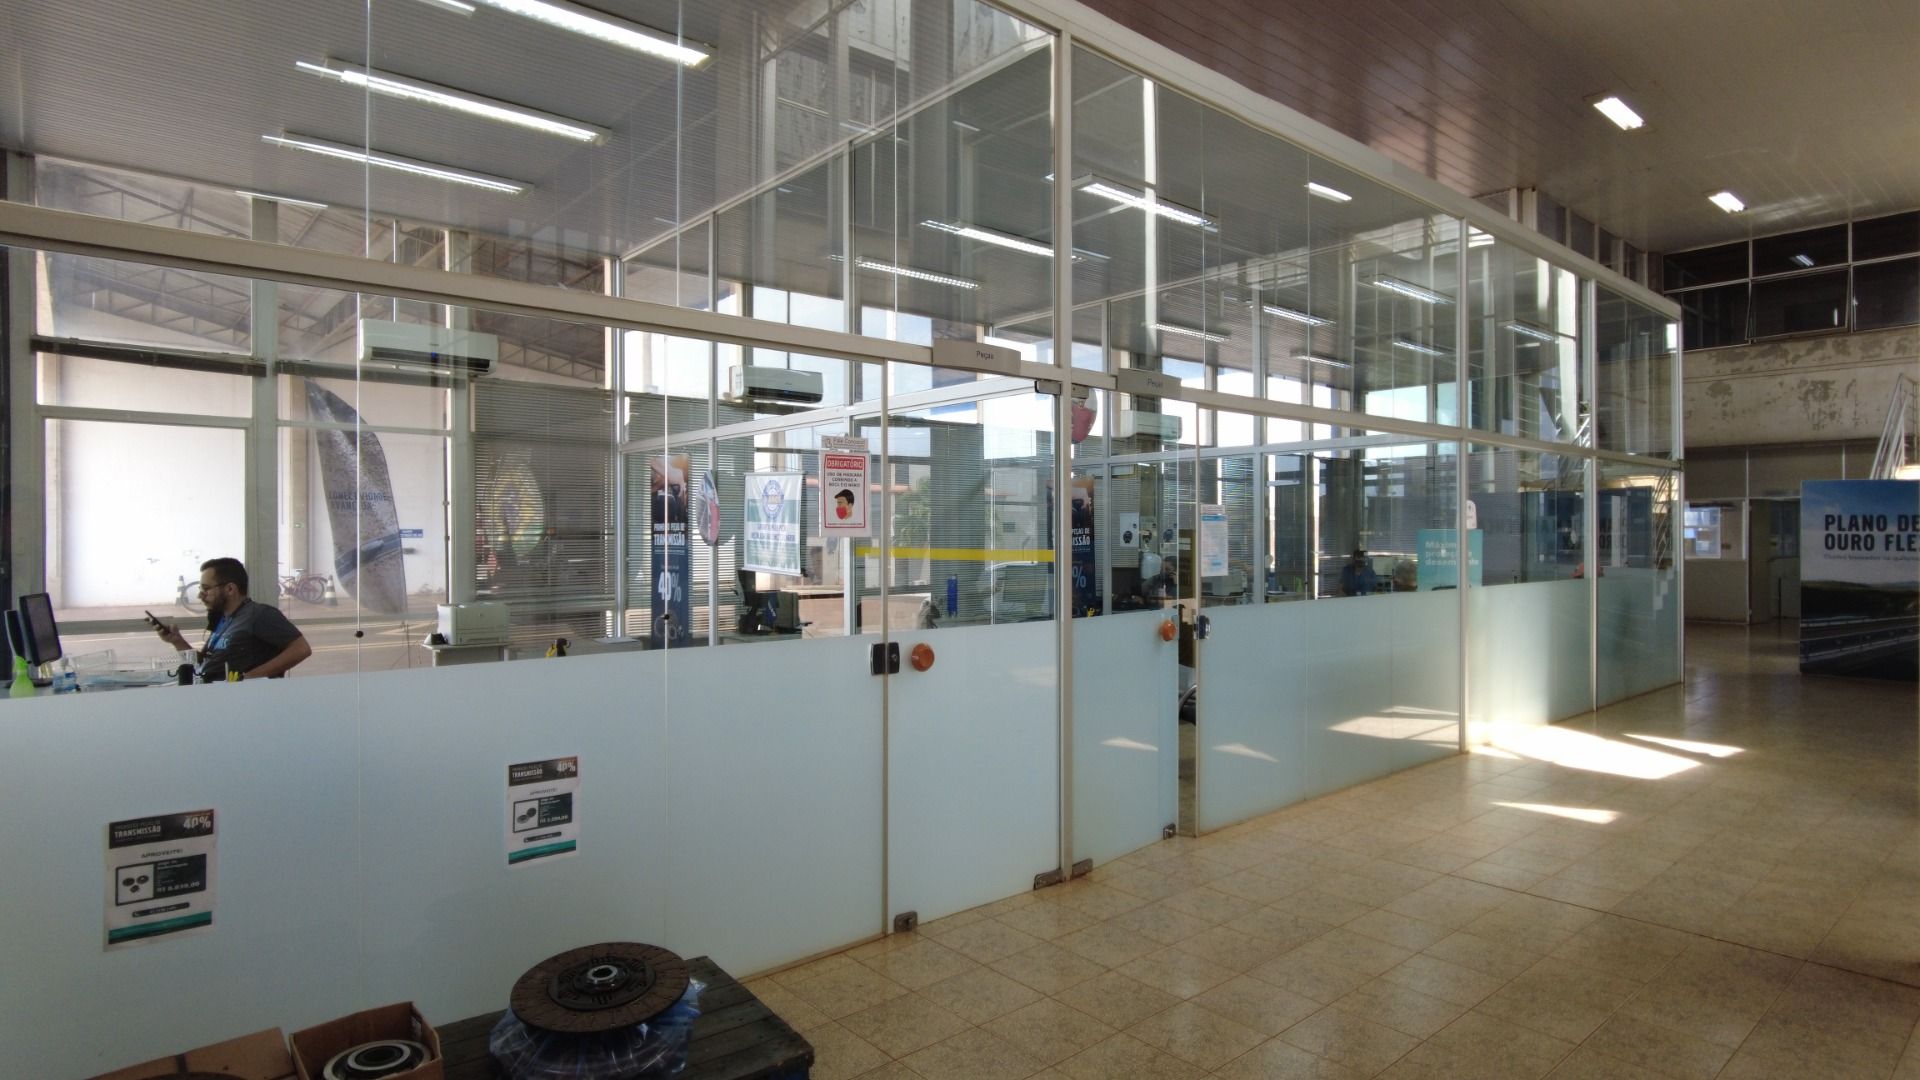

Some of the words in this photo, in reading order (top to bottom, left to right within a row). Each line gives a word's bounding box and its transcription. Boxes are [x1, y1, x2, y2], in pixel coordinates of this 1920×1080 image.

[976, 350, 994, 361] Peças
[827, 459, 863, 469] OBRIGATÓRIO
[1824, 514, 1888, 532] PLANO
[1897, 514, 1920, 532] DE
[1824, 533, 1875, 551] OURO
[1885, 534, 1920, 552] FLE
[659, 572, 682, 601] 40%
[557, 762, 576, 772] 40%
[183, 815, 212, 830] 40%
[114, 824, 161, 839] TRANSMISSÃO
